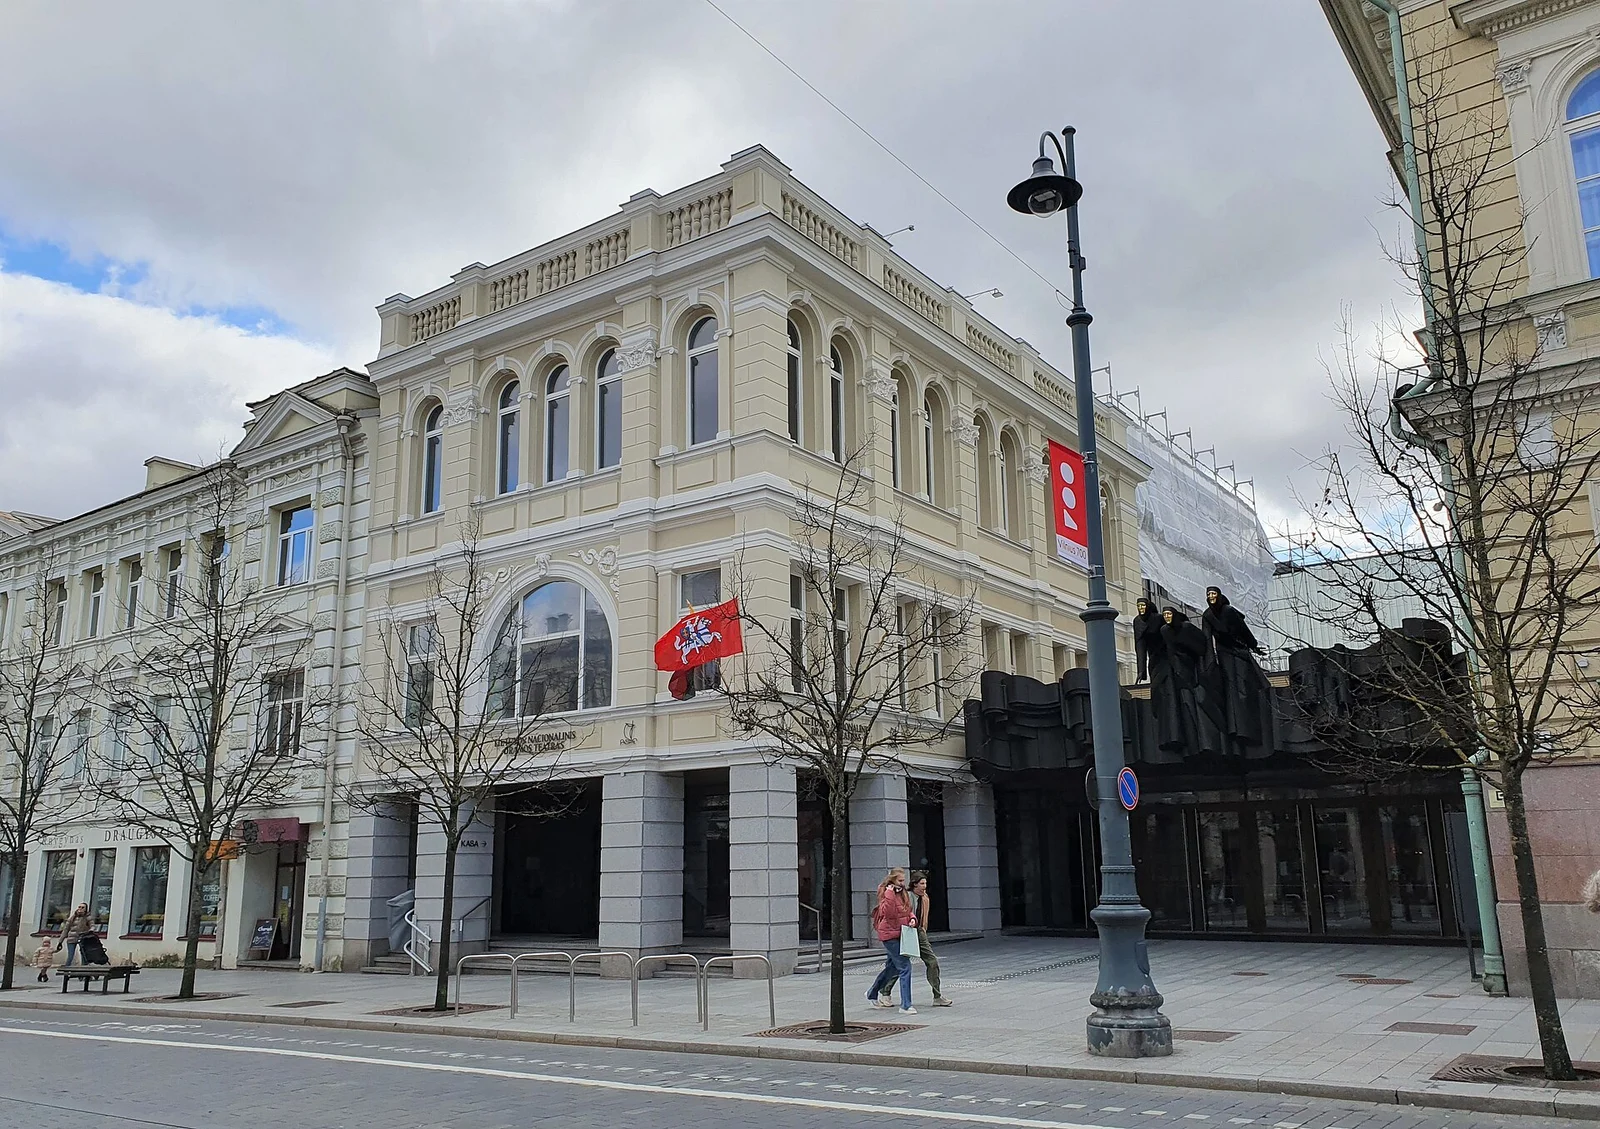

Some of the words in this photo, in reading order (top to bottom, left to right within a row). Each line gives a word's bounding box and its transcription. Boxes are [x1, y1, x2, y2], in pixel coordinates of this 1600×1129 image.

[1058, 539, 1076, 555] Vilnius
[1077, 547, 1087, 560] 700
[527, 731, 577, 744] NACIONALINIS
[534, 742, 565, 752] TEATRAS
[460, 840, 479, 848] KASA
